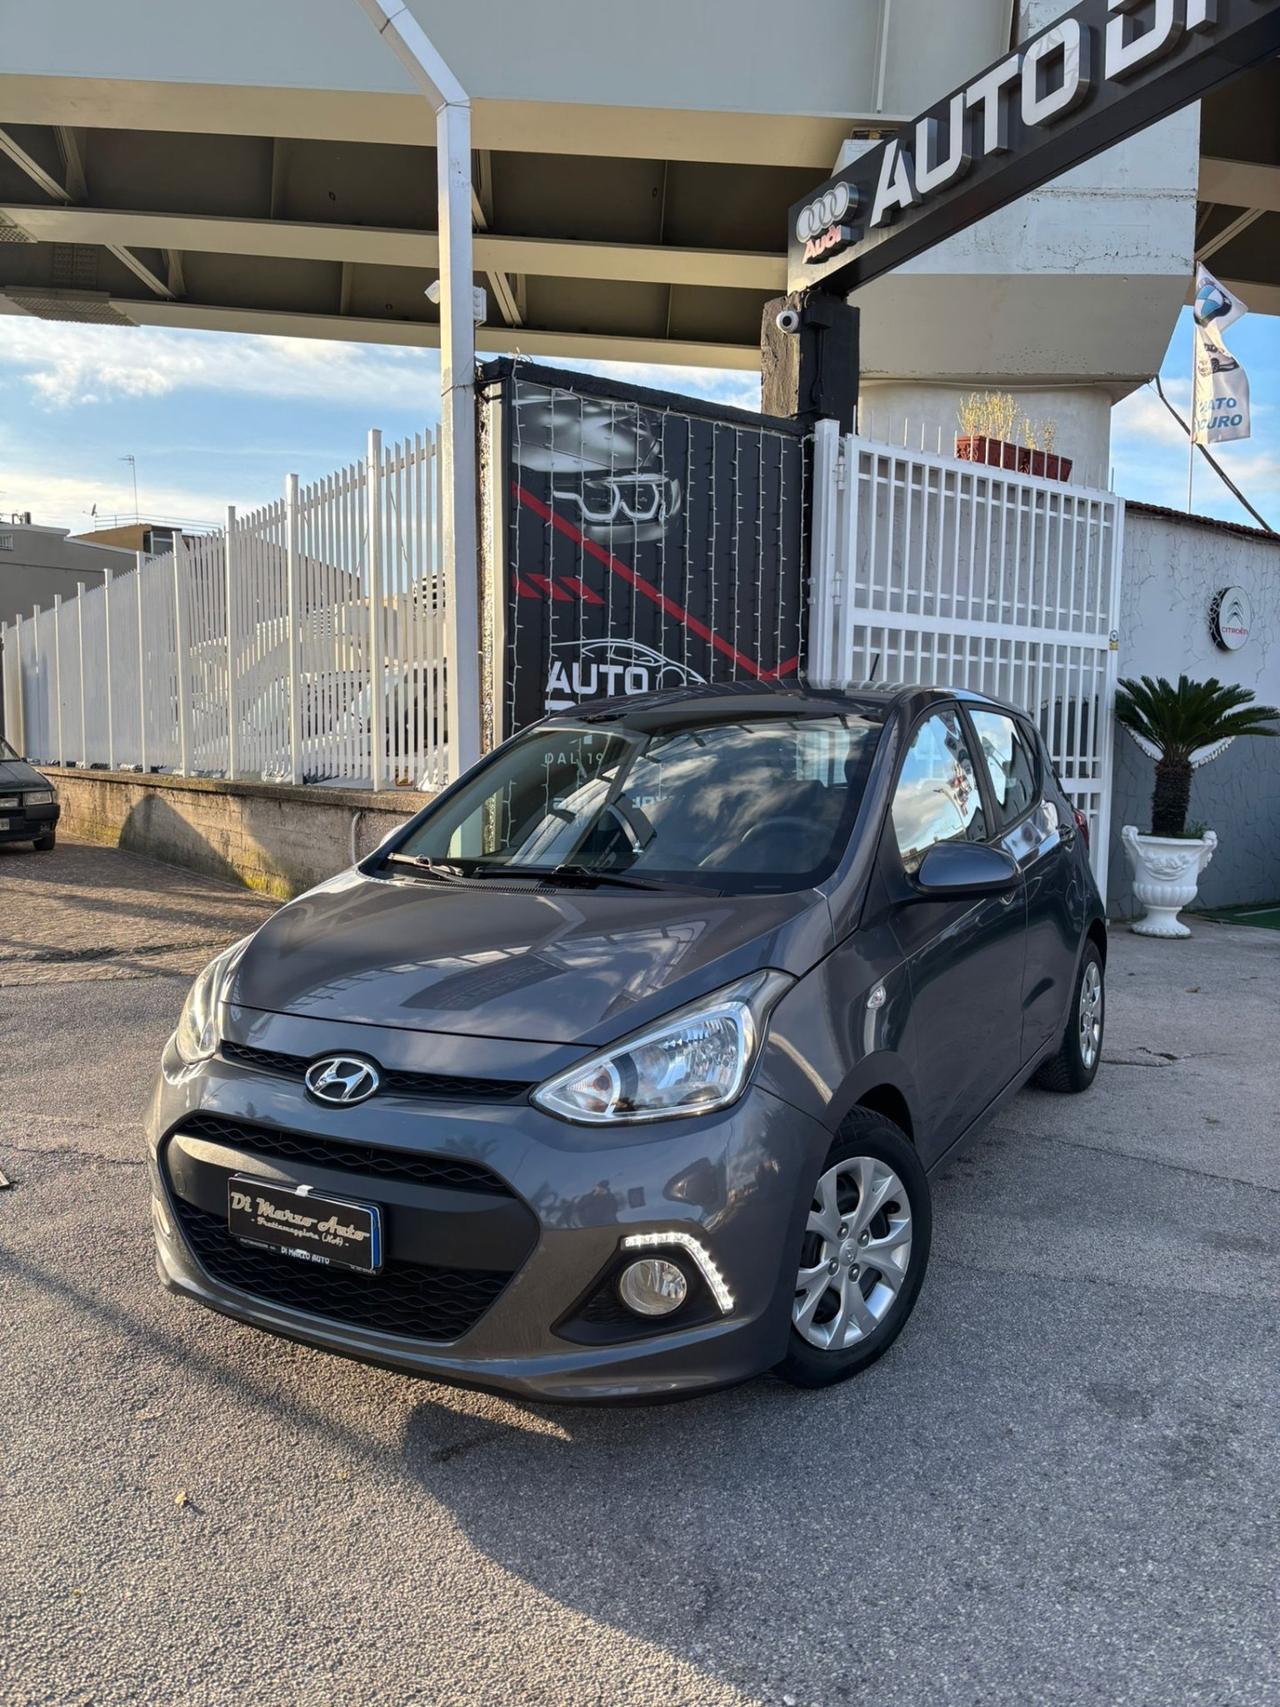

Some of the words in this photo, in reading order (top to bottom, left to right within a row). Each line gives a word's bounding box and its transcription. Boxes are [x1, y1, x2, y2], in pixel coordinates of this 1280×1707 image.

[870, 18, 1083, 228] AUTO
[545, 661, 649, 698] AUTO
[317, 1215, 371, 1241] Auto
